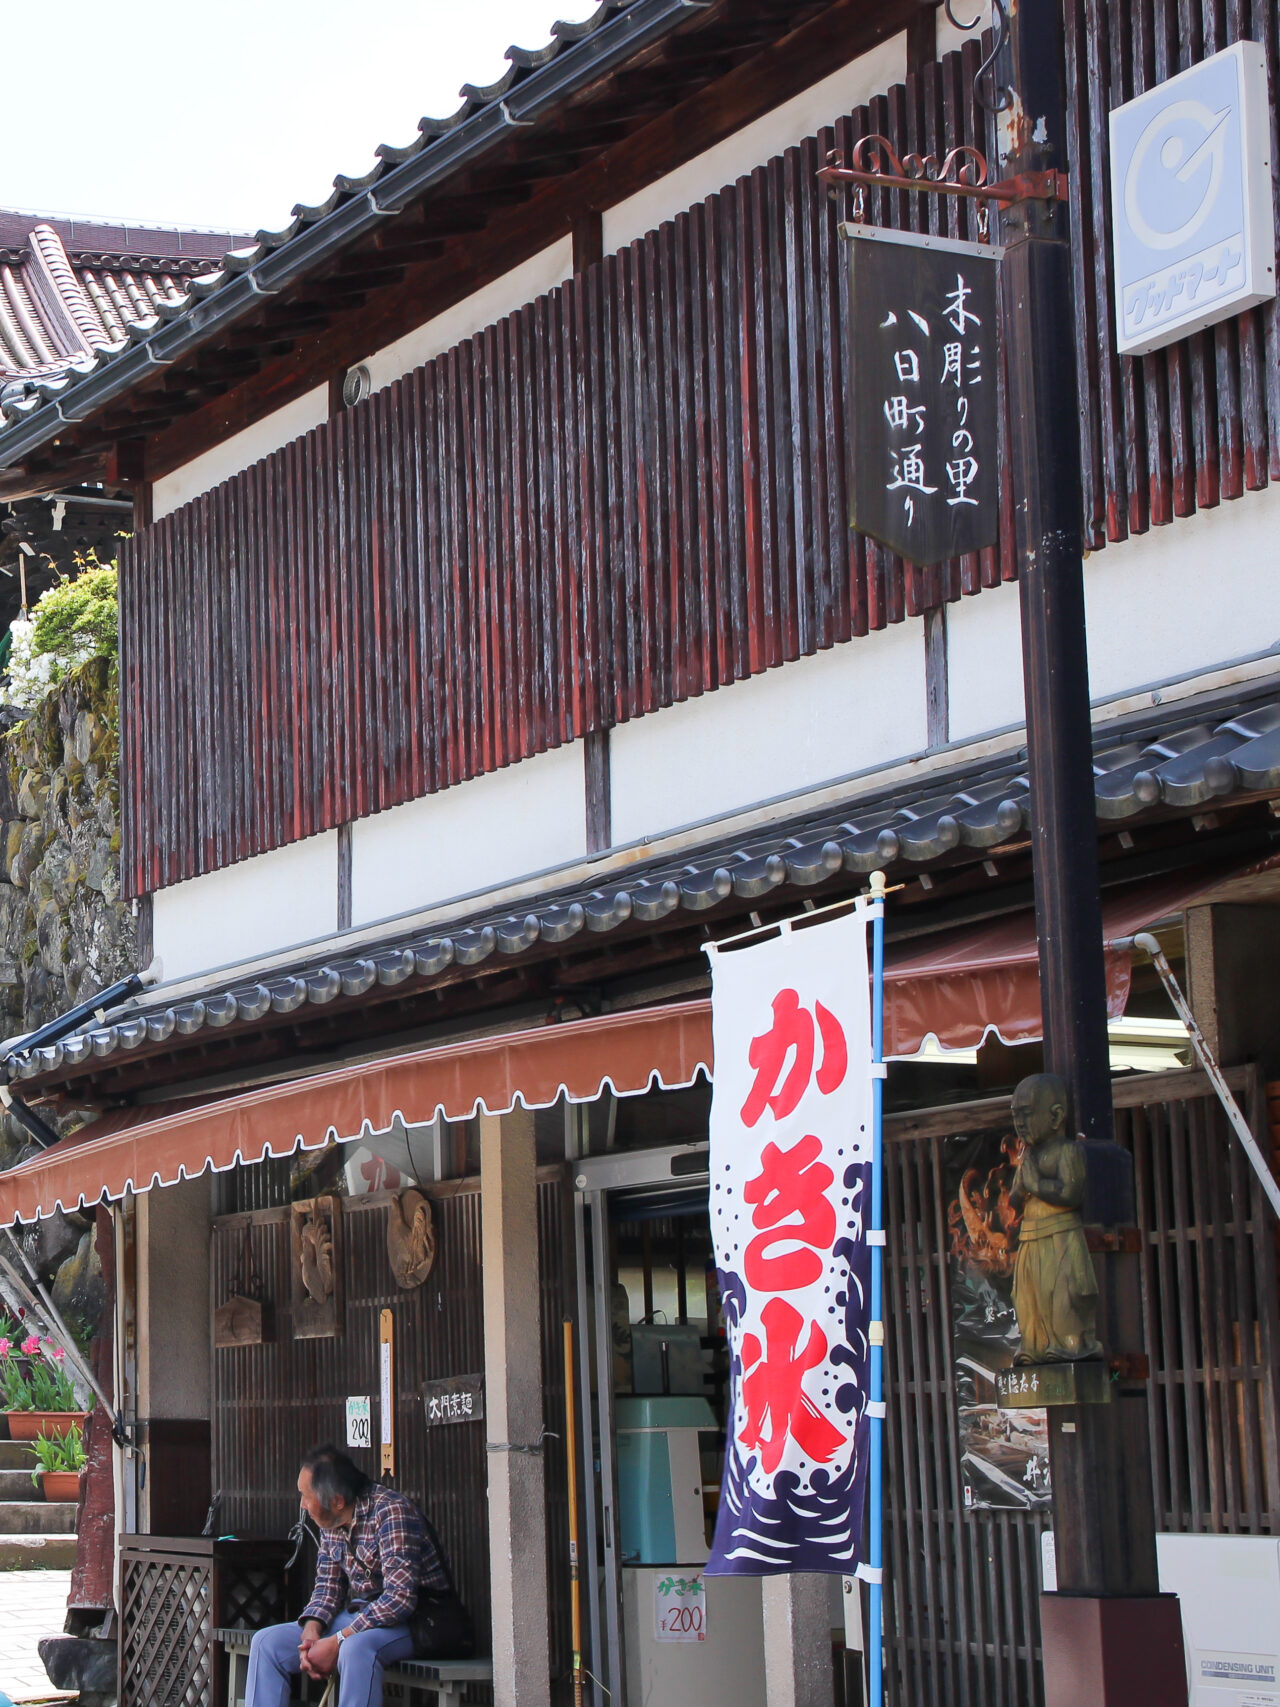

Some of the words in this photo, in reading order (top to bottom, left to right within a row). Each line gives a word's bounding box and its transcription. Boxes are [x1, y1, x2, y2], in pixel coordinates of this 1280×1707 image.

[1126, 246, 1242, 326] グッドマート
[941, 272, 982, 507] 木彫りの里
[879, 309, 939, 527] 八日町通り
[738, 987, 848, 1475] かき氷
[997, 1373, 1039, 1396] 聖徳太子
[428, 1391, 473, 1420] 大門素麺
[351, 1418, 369, 1441] 200
[657, 1576, 705, 1597] かき氷
[660, 1605, 703, 1633] ¥200
[1200, 1660, 1253, 1674] CONDENSING
[1254, 1664, 1275, 1675] UNIT
